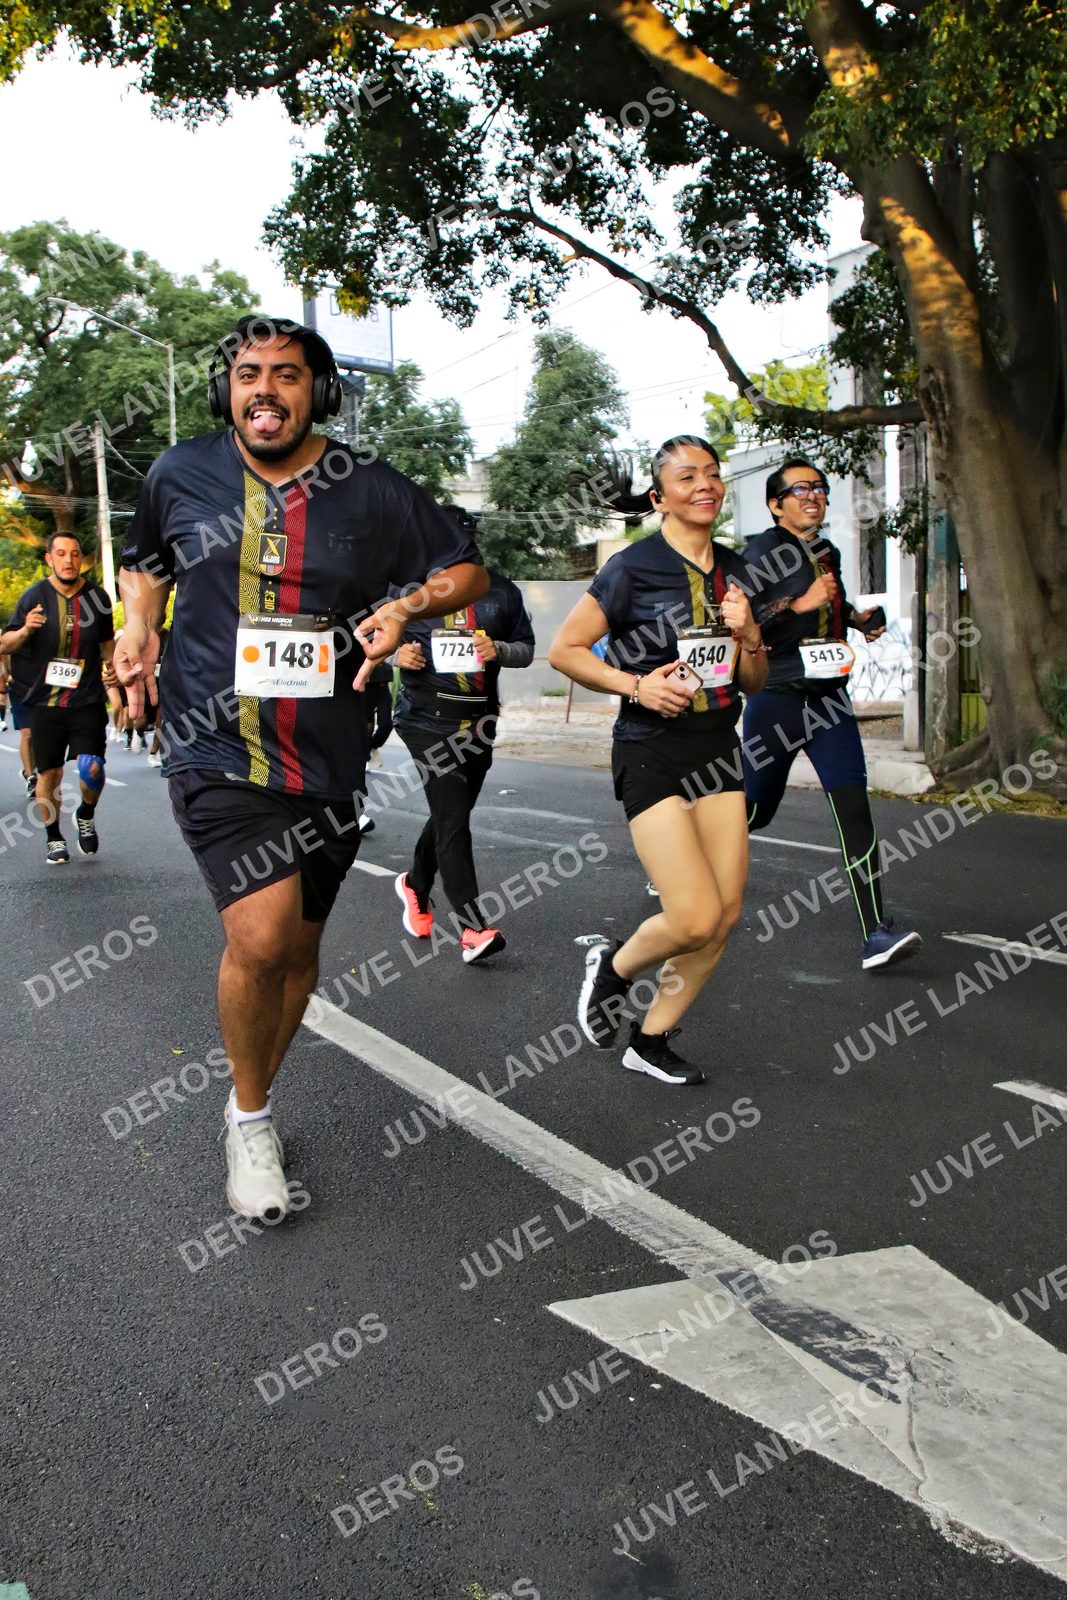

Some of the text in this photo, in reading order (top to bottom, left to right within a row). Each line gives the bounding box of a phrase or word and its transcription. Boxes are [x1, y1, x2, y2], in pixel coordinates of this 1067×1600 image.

[265, 641, 314, 668] 148
[440, 643, 474, 656] 7724
[687, 645, 726, 668] 4540
[810, 648, 844, 663] 5415
[52, 666, 77, 677] 5369
